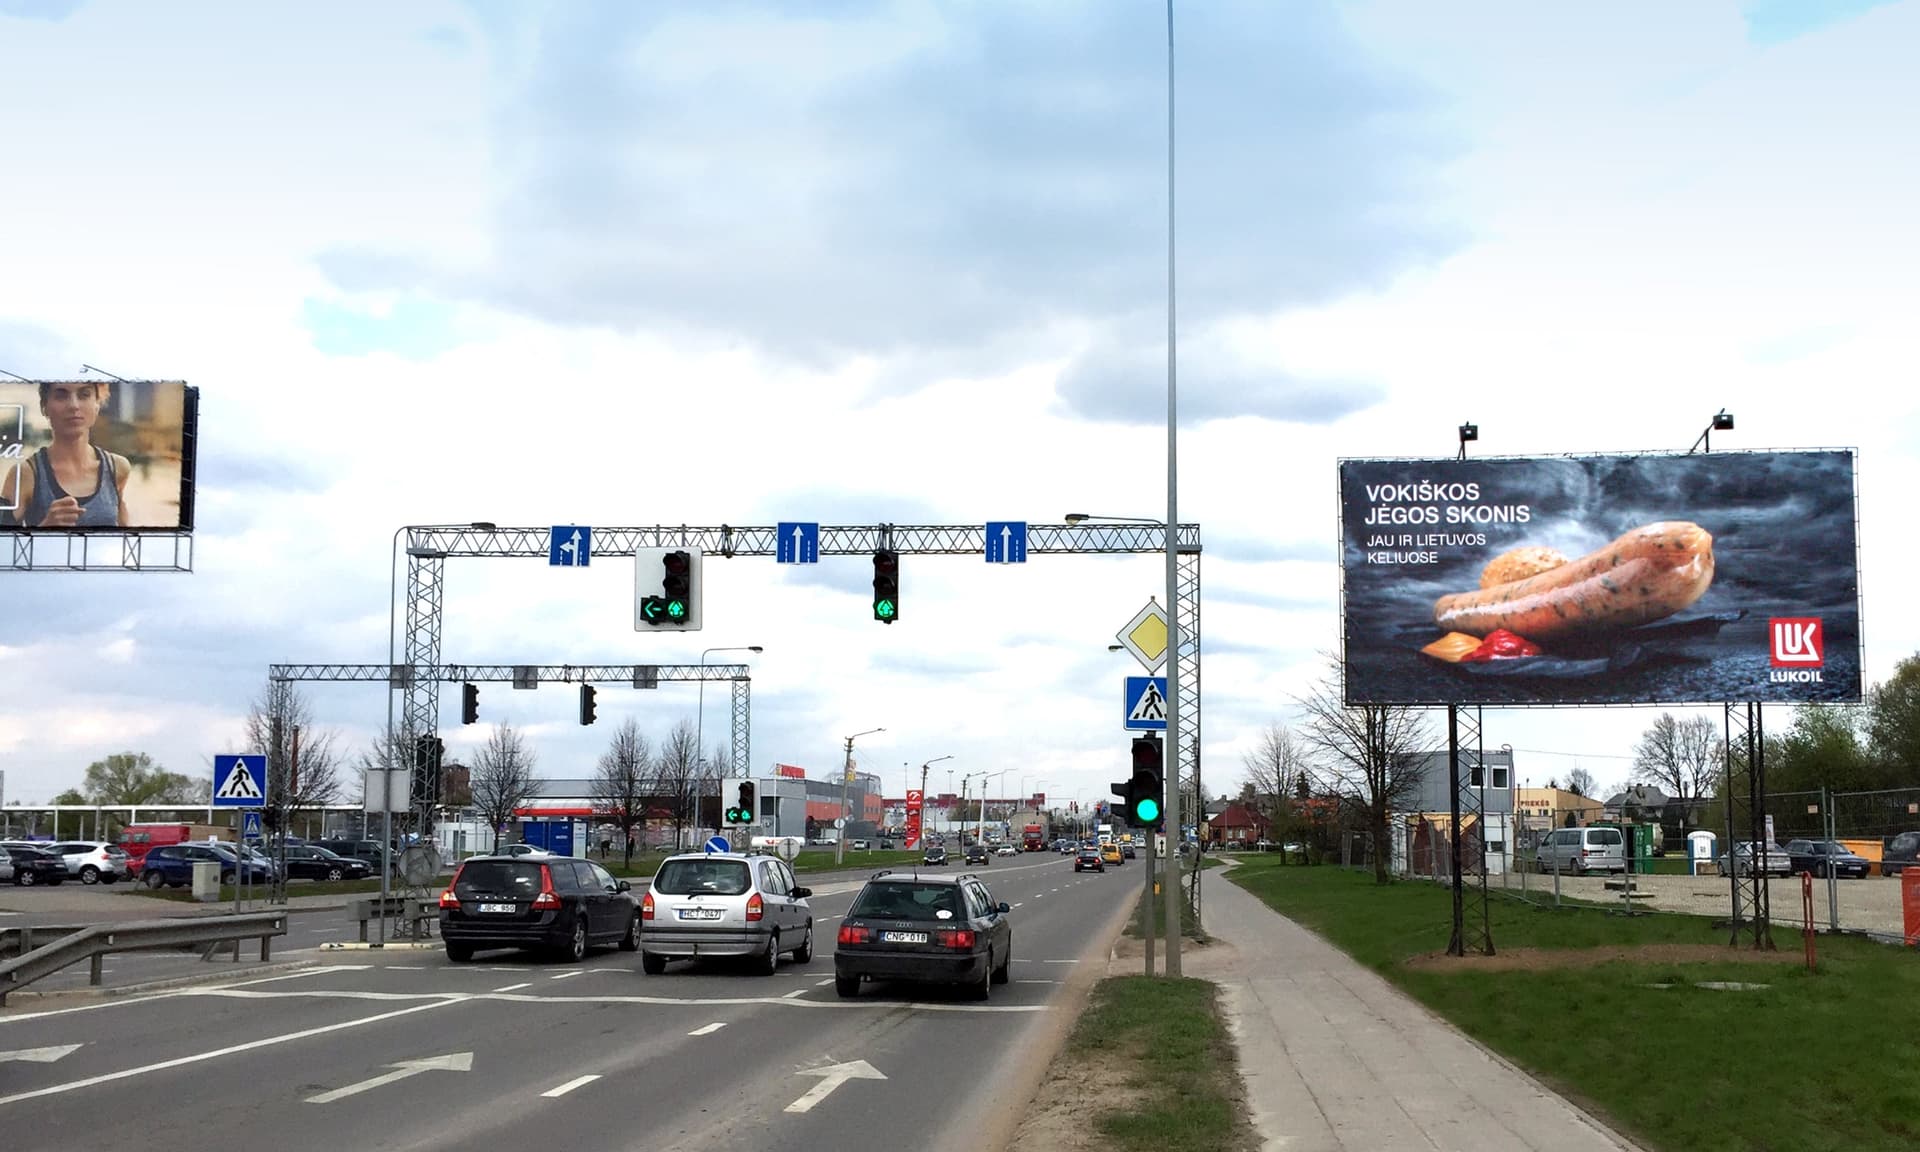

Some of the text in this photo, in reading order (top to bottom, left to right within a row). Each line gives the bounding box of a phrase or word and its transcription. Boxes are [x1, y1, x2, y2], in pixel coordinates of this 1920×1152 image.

[1365, 480, 1480, 502] VOKIŠKOS
[1364, 504, 1531, 525] JĖGOS SKONIS
[1367, 533, 1486, 547] JAU IR LIETUVOS
[1367, 551, 1439, 564] KELIUOSE
[1770, 670, 1824, 683] LUKOIL
